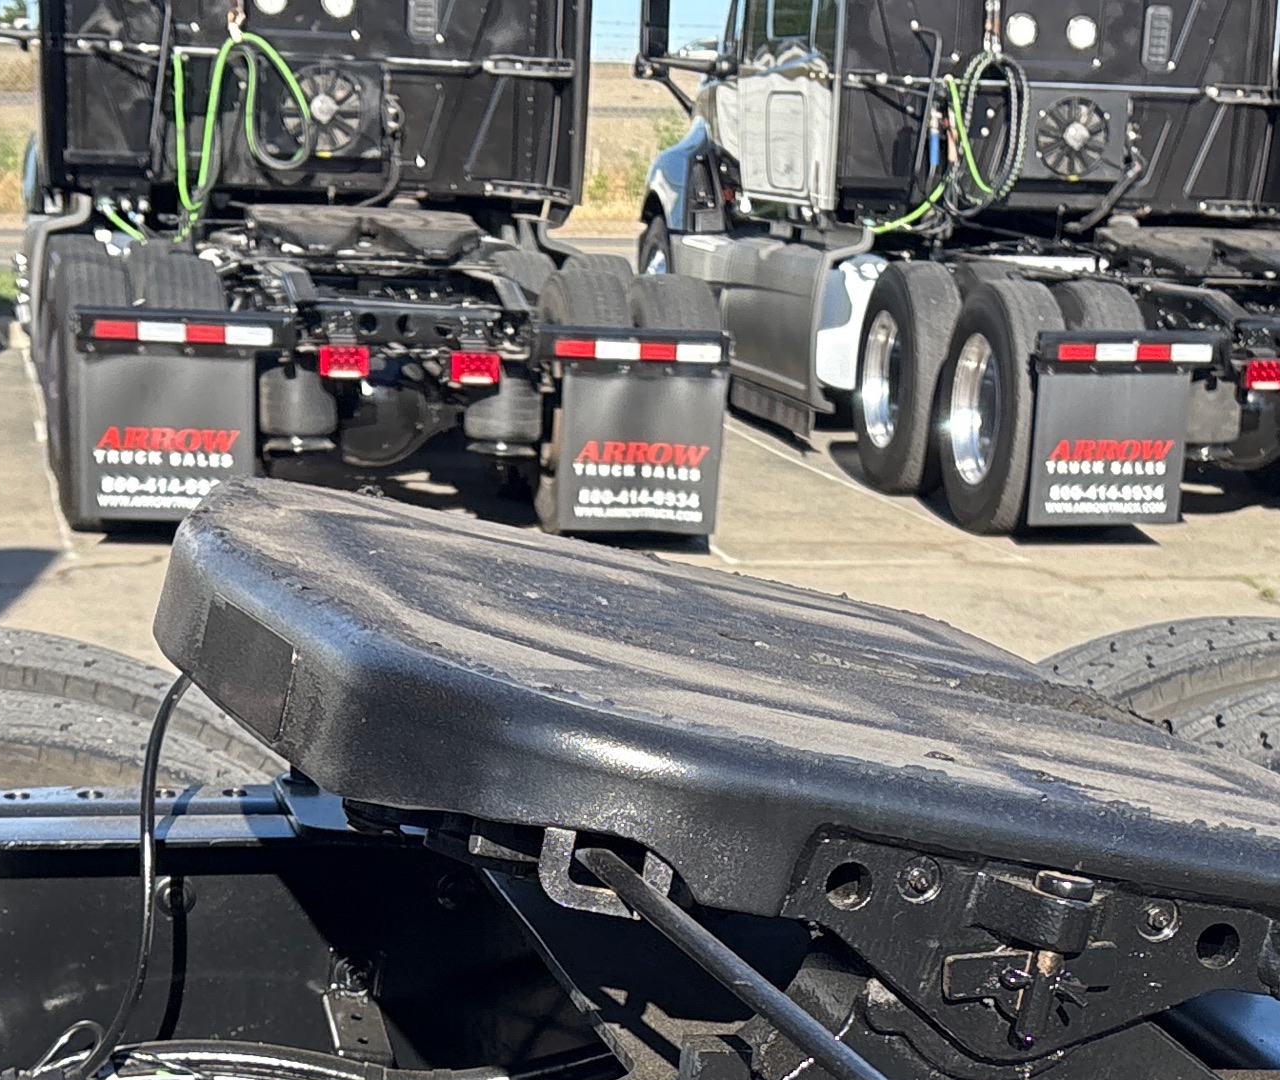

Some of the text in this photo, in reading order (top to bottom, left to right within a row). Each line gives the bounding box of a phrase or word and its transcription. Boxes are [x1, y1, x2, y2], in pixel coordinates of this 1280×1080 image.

[96, 426, 240, 452] ARROW
[93, 449, 234, 468] TRUCK SALES
[573, 440, 710, 467] ARROW
[1048, 439, 1175, 461] ARROW
[573, 463, 701, 482] TRUCK SALES
[1045, 460, 1166, 475] TRUCK SALES
